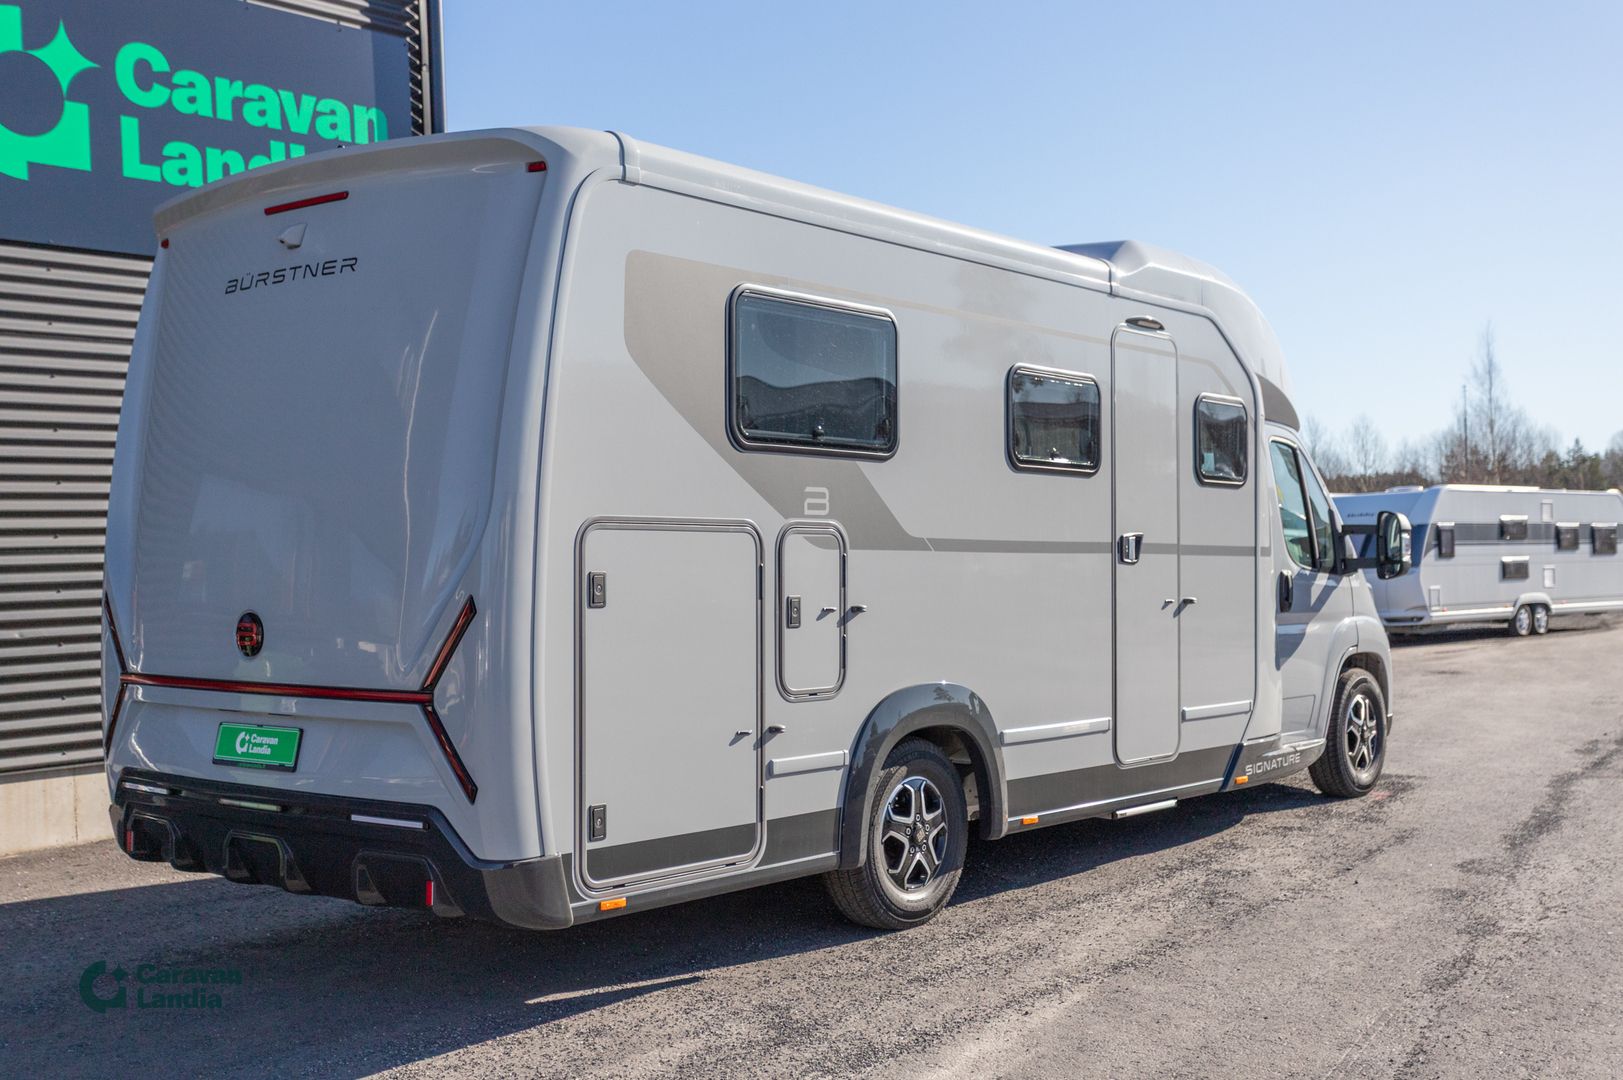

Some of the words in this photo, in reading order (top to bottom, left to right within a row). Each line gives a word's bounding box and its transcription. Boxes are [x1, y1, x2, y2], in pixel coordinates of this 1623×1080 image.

[115, 42, 388, 145] Caravan
[120, 115, 306, 188] Lan
[225, 257, 358, 294] BÜRSTNER
[248, 743, 271, 755] Landia
[250, 733, 279, 745] Caravan
[1245, 752, 1301, 776] SIGNATURE
